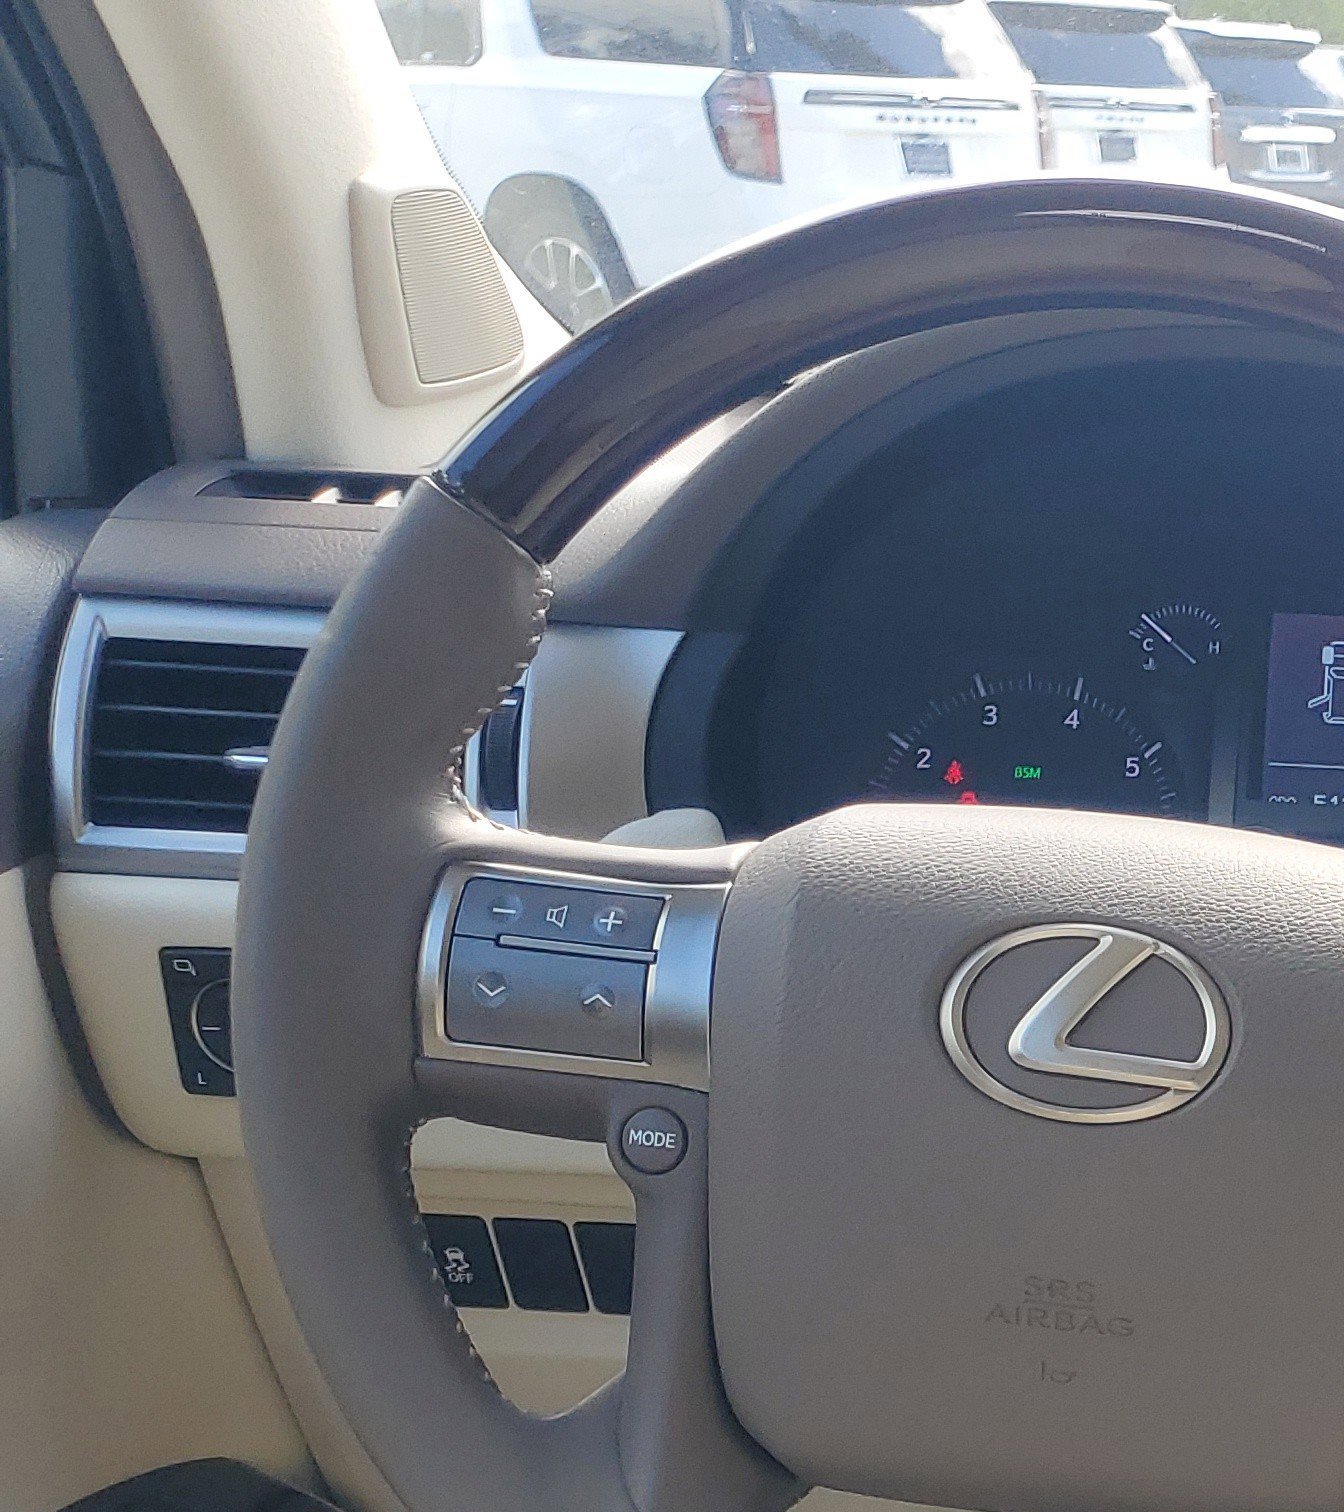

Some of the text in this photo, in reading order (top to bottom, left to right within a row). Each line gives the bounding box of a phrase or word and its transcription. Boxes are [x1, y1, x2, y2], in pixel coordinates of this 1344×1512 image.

[983, 705, 998, 726] 3
[1063, 709, 1080, 729] 4
[915, 748, 931, 770] 2
[1125, 757, 1140, 778] 5
[1014, 765, 1041, 780] BSM
[628, 1128, 676, 1149] MODE
[447, 1272, 474, 1285] OFF
[983, 1303, 1136, 1338] AIRBAG
